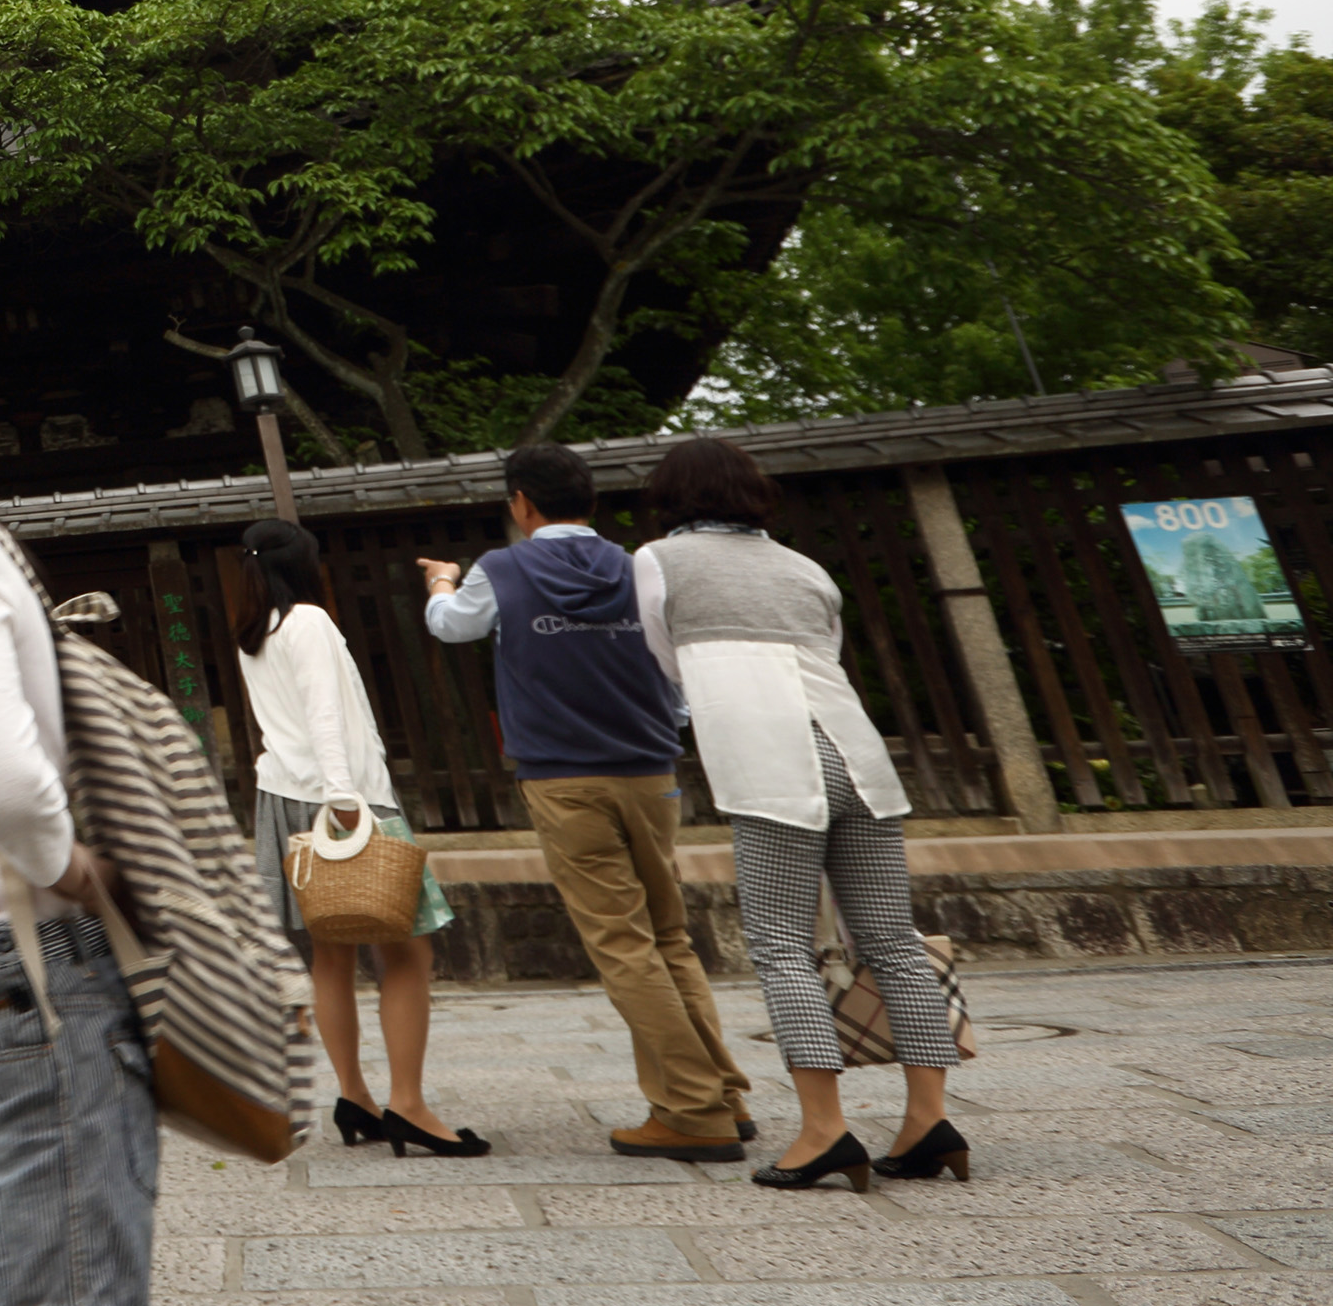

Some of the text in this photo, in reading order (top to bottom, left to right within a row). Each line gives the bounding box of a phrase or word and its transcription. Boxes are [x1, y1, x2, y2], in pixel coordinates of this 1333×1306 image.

[1154, 501, 1229, 532] 800
[162, 593, 210, 755] 聖徳太子御
